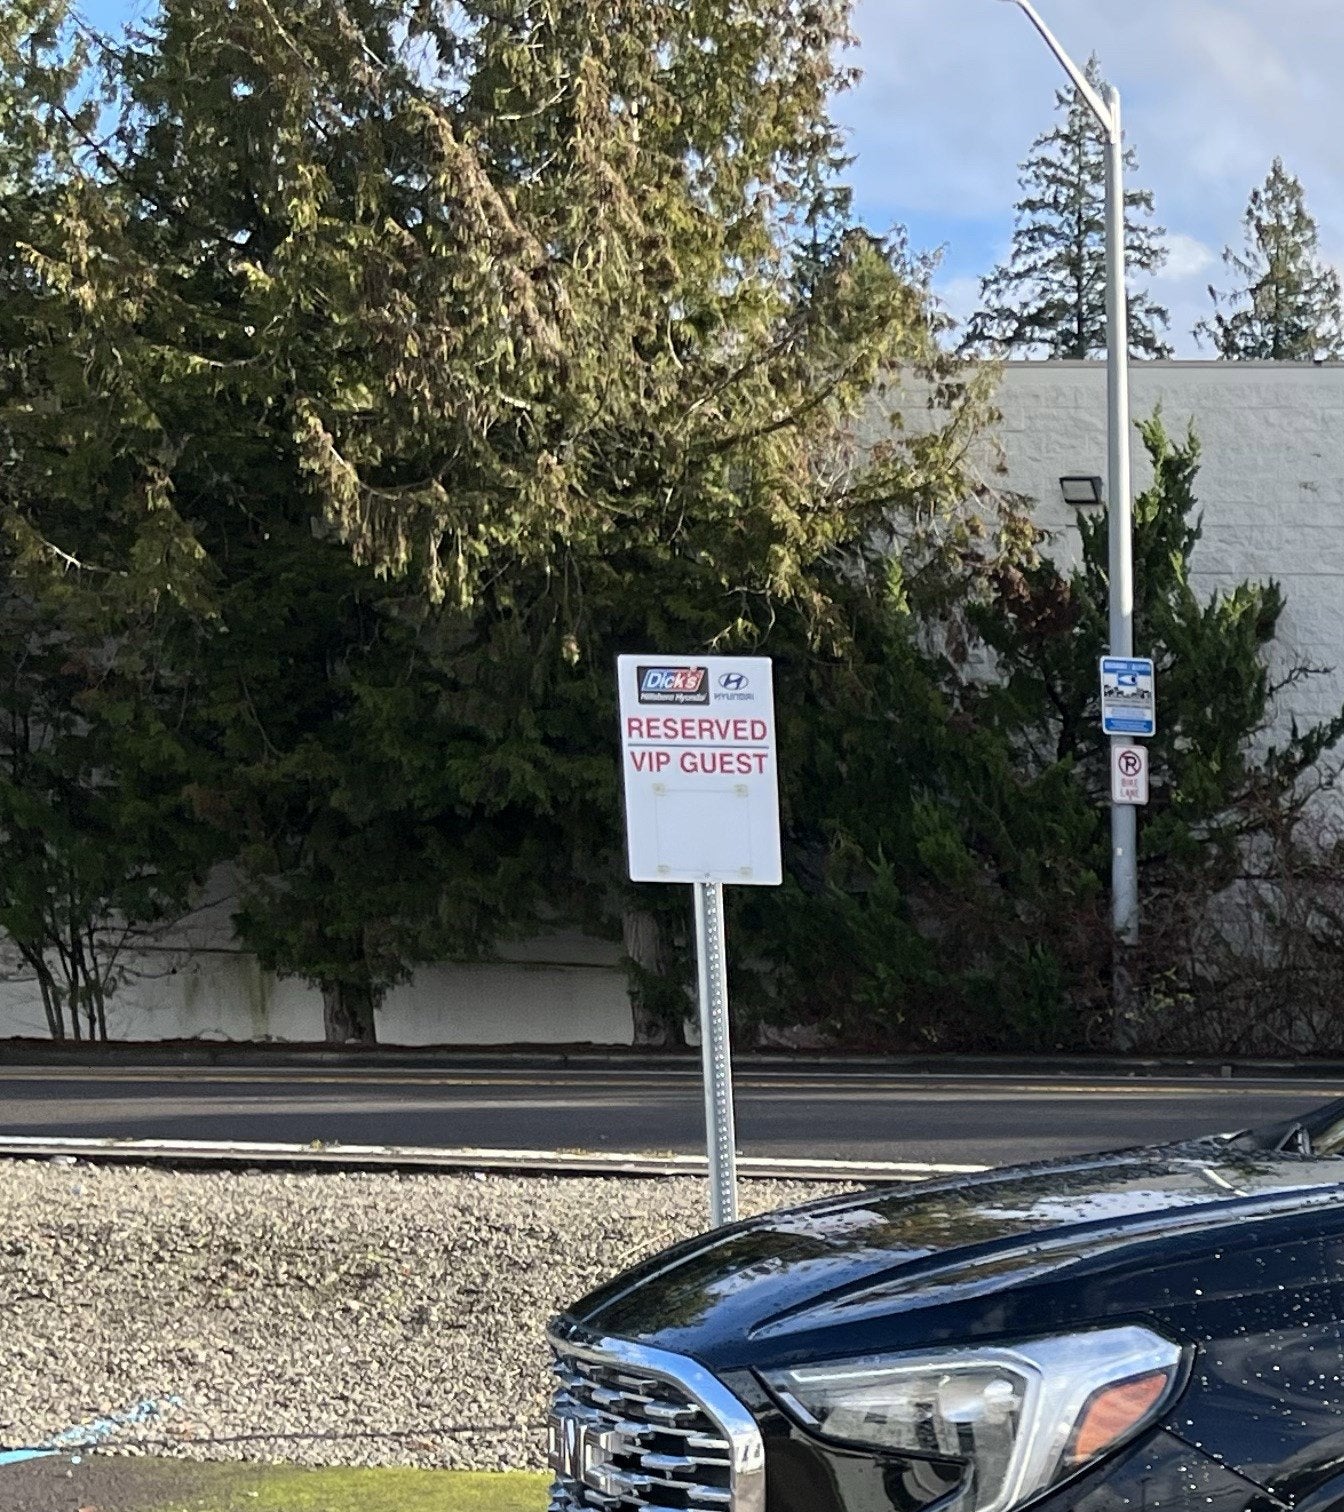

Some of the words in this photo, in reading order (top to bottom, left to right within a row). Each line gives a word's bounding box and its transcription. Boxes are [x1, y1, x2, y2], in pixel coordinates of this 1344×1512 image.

[627, 717, 768, 741] RESERVED
[630, 751, 671, 773] VIP
[680, 752, 769, 775] GUEST
